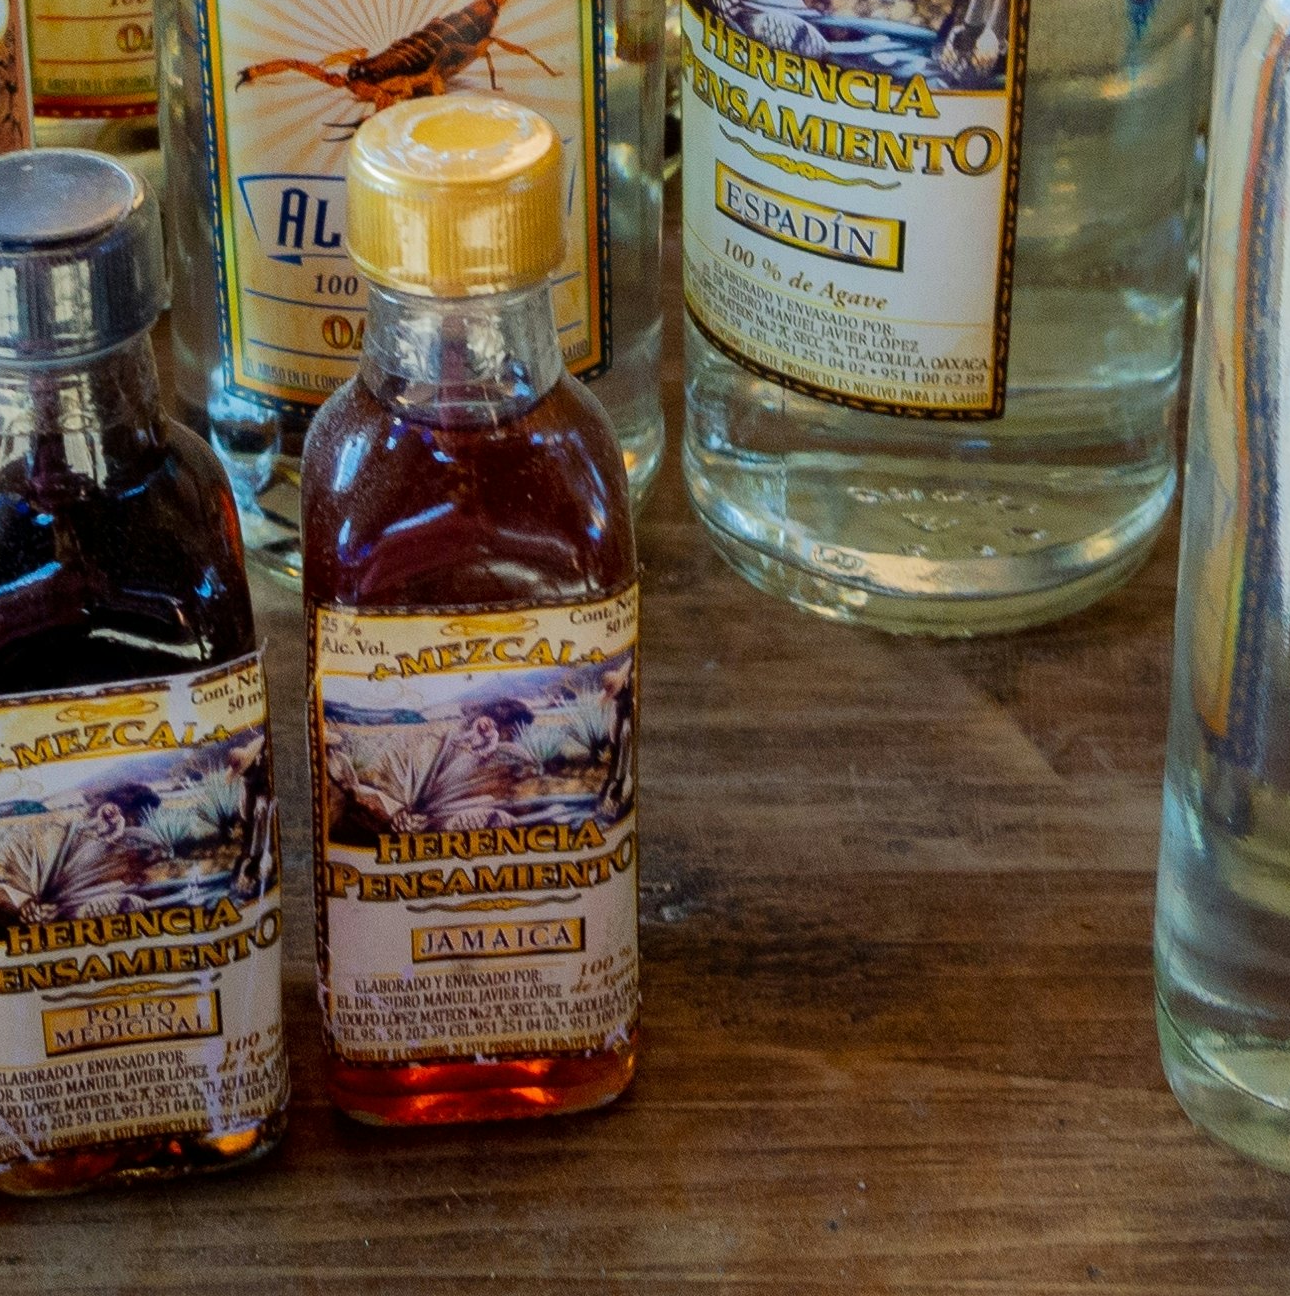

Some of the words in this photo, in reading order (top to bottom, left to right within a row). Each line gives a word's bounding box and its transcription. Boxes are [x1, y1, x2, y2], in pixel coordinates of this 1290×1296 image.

[703, 6, 941, 119] HERENCIA
[724, 180, 878, 260] ESPADÍN
[314, 274, 359, 296] 100
[723, 237, 755, 269] 100
[761, 258, 782, 282] %
[789, 270, 814, 293] de
[818, 281, 889, 311] Agave
[786, 300, 859, 329] ENVASADO
[396, 636, 579, 679] MEZCAL
[11, 720, 202, 770] MEZCAL
[376, 819, 606, 864] HERENCIA
[327, 830, 635, 902] PENSAMIENTO
[5, 897, 244, 958] HERENCIA
[421, 925, 574, 955] JAMAICA
[55, 1013, 210, 1048] MEDICINAL
[88, 1000, 177, 1025] POLEO
